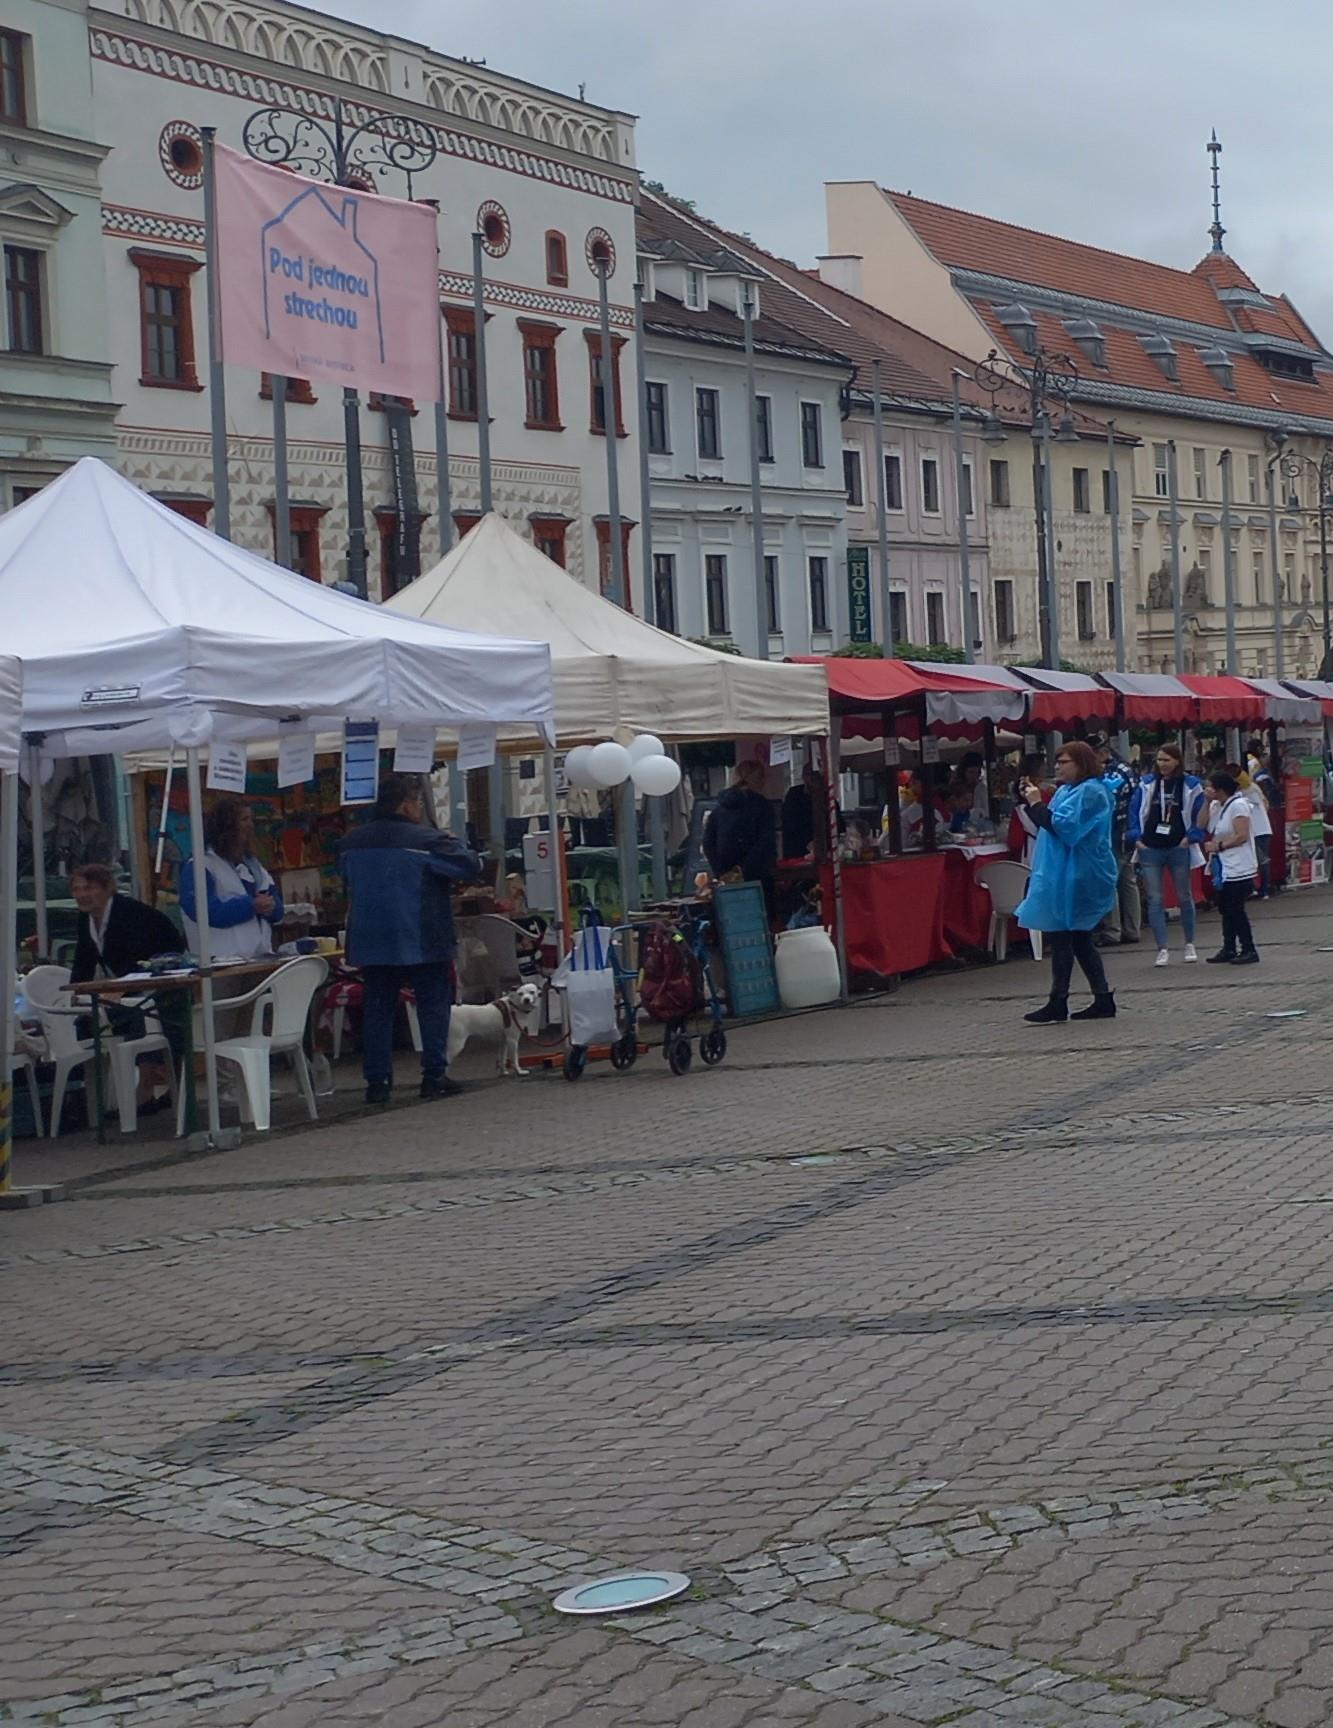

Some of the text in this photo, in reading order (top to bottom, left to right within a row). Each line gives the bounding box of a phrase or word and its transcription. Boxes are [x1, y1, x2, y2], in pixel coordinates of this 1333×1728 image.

[270, 247, 369, 298] Pod jednou
[284, 292, 358, 330] strechou
[851, 562, 867, 634] HOTEL
[537, 842, 548, 859] 5
